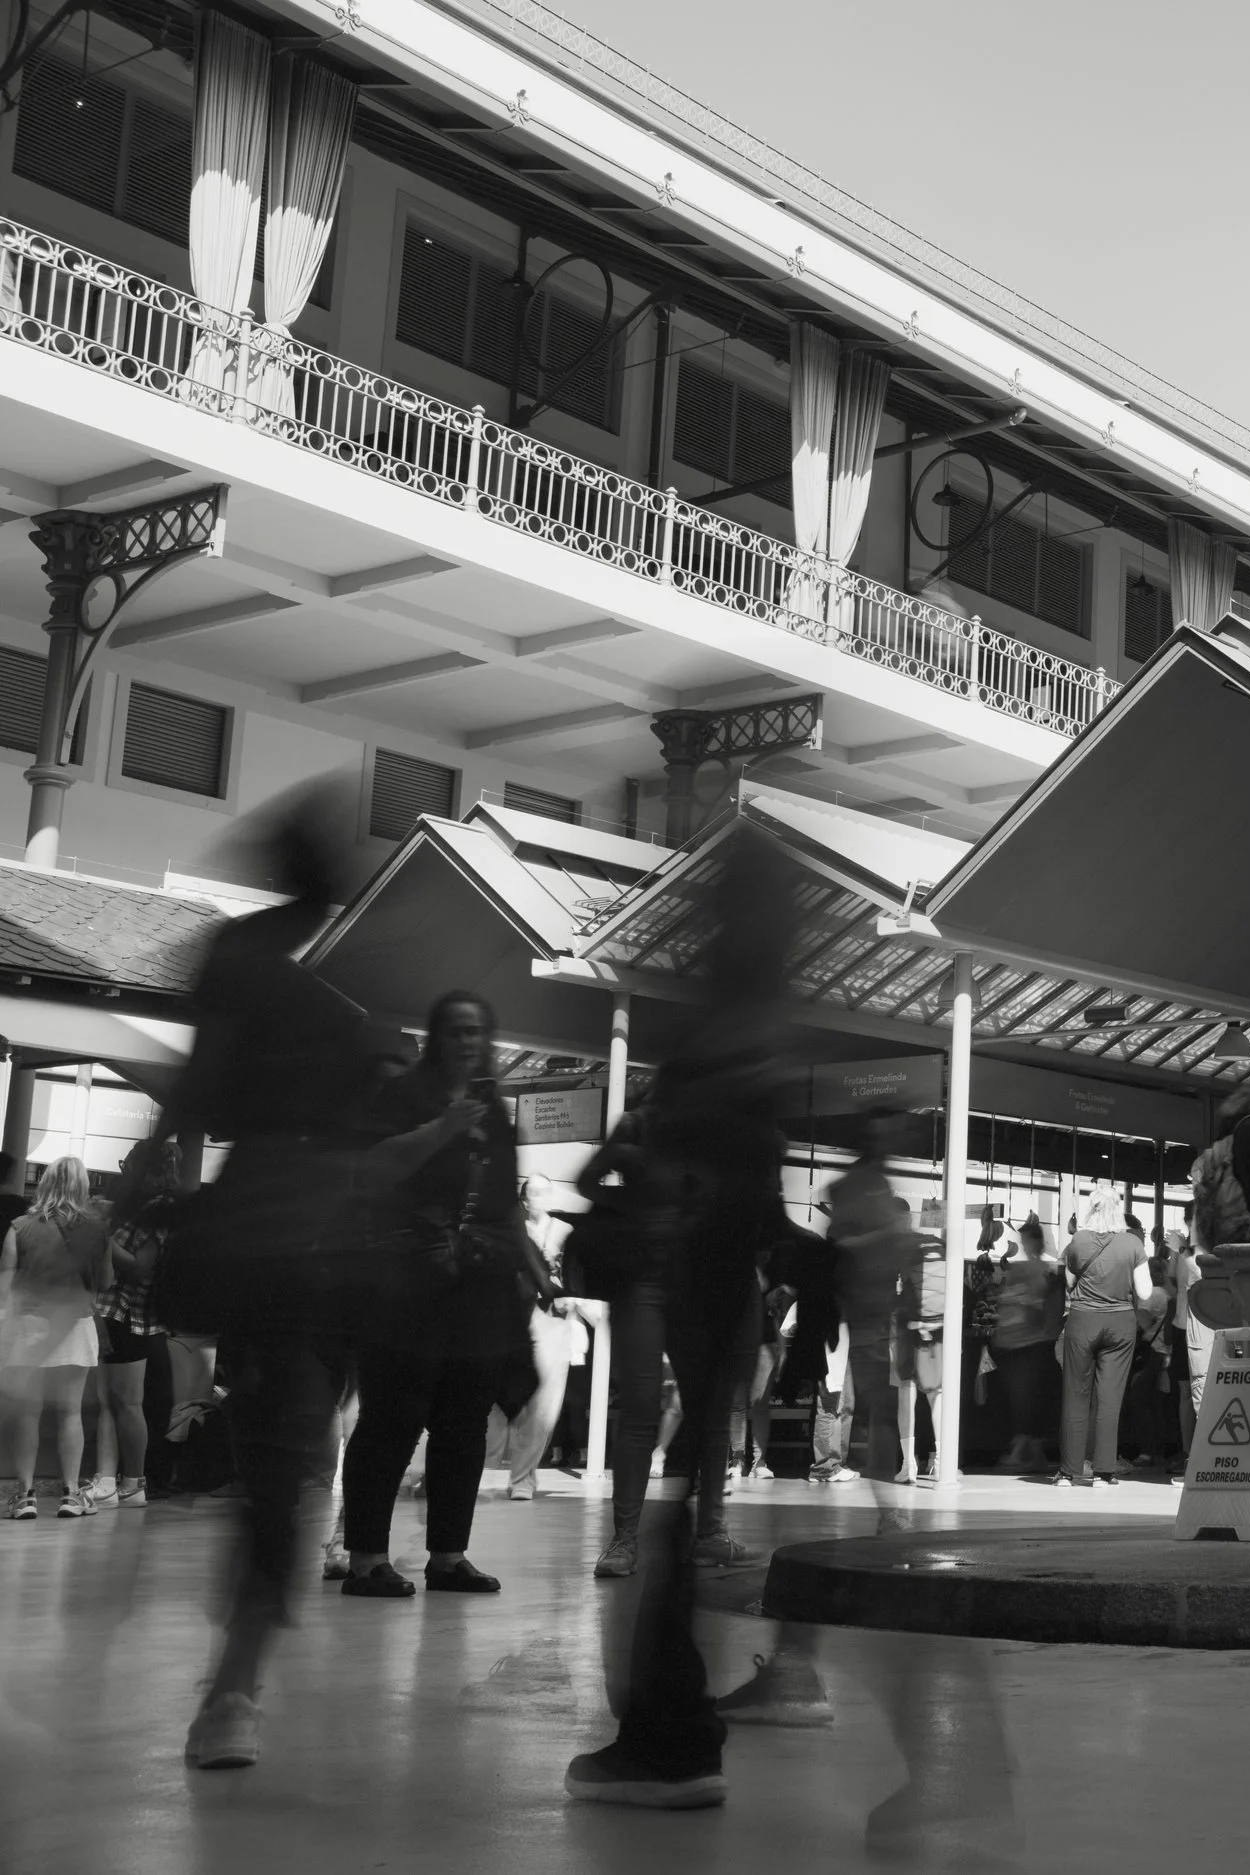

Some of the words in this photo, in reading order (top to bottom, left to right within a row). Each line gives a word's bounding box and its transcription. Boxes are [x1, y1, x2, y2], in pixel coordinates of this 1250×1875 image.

[843, 1076, 867, 1086] Frutas
[868, 1072, 907, 1084] Ermelinda
[851, 1087, 858, 1097] &
[859, 1085, 898, 1096] Gertrudes
[1214, 1456, 1239, 1468] PISO
